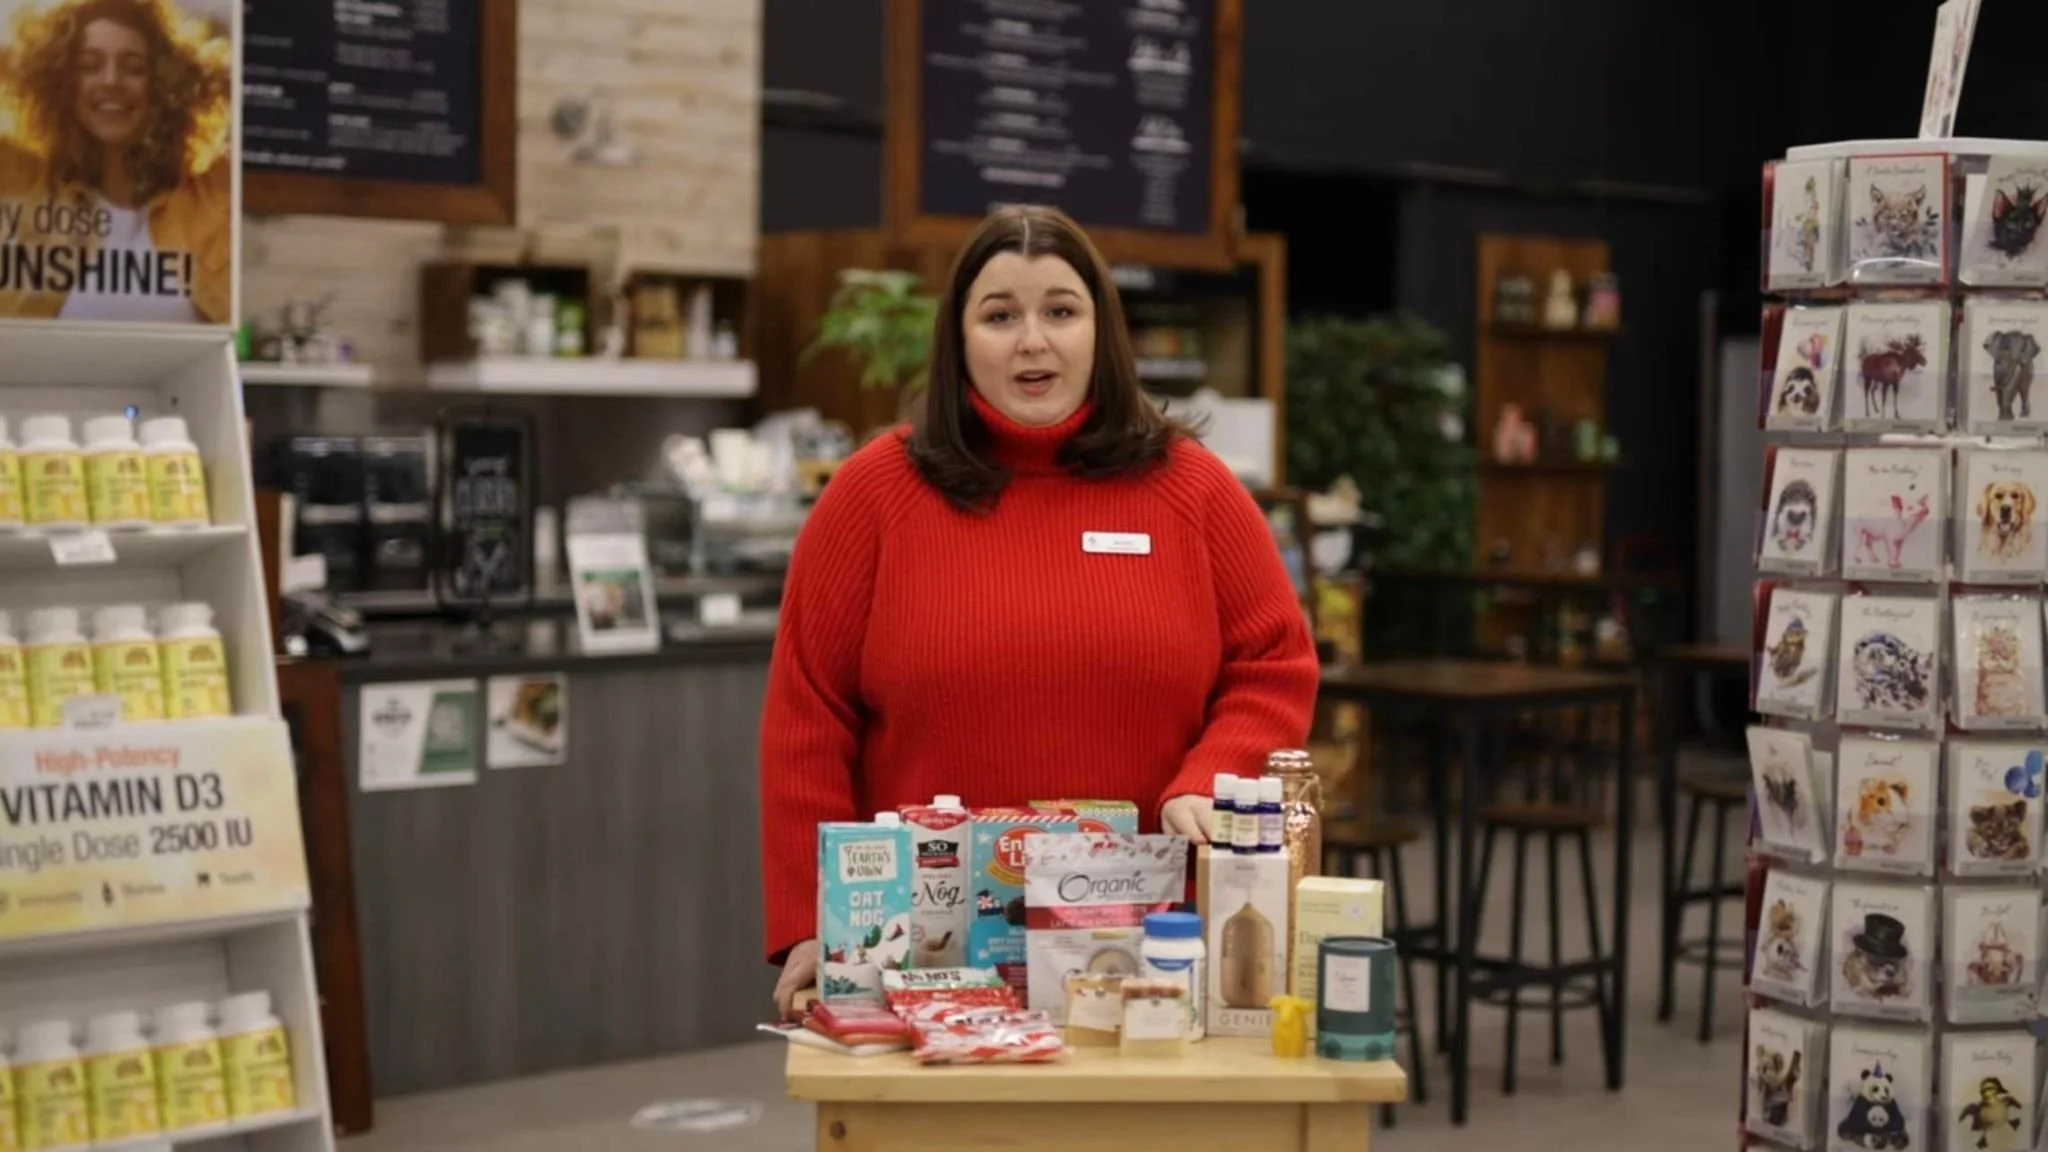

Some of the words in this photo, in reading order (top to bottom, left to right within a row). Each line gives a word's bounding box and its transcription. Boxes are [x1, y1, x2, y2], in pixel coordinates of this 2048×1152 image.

[34, 197, 112, 238] dose
[0, 777, 164, 826] VITAMIN
[175, 772, 224, 813] D3
[72, 827, 140, 863] Dose
[151, 819, 218, 855] 2500
[226, 817, 253, 849] IU
[849, 890, 885, 908] OAT
[1057, 869, 1147, 903] Organic
[850, 908, 885, 927] NOG
